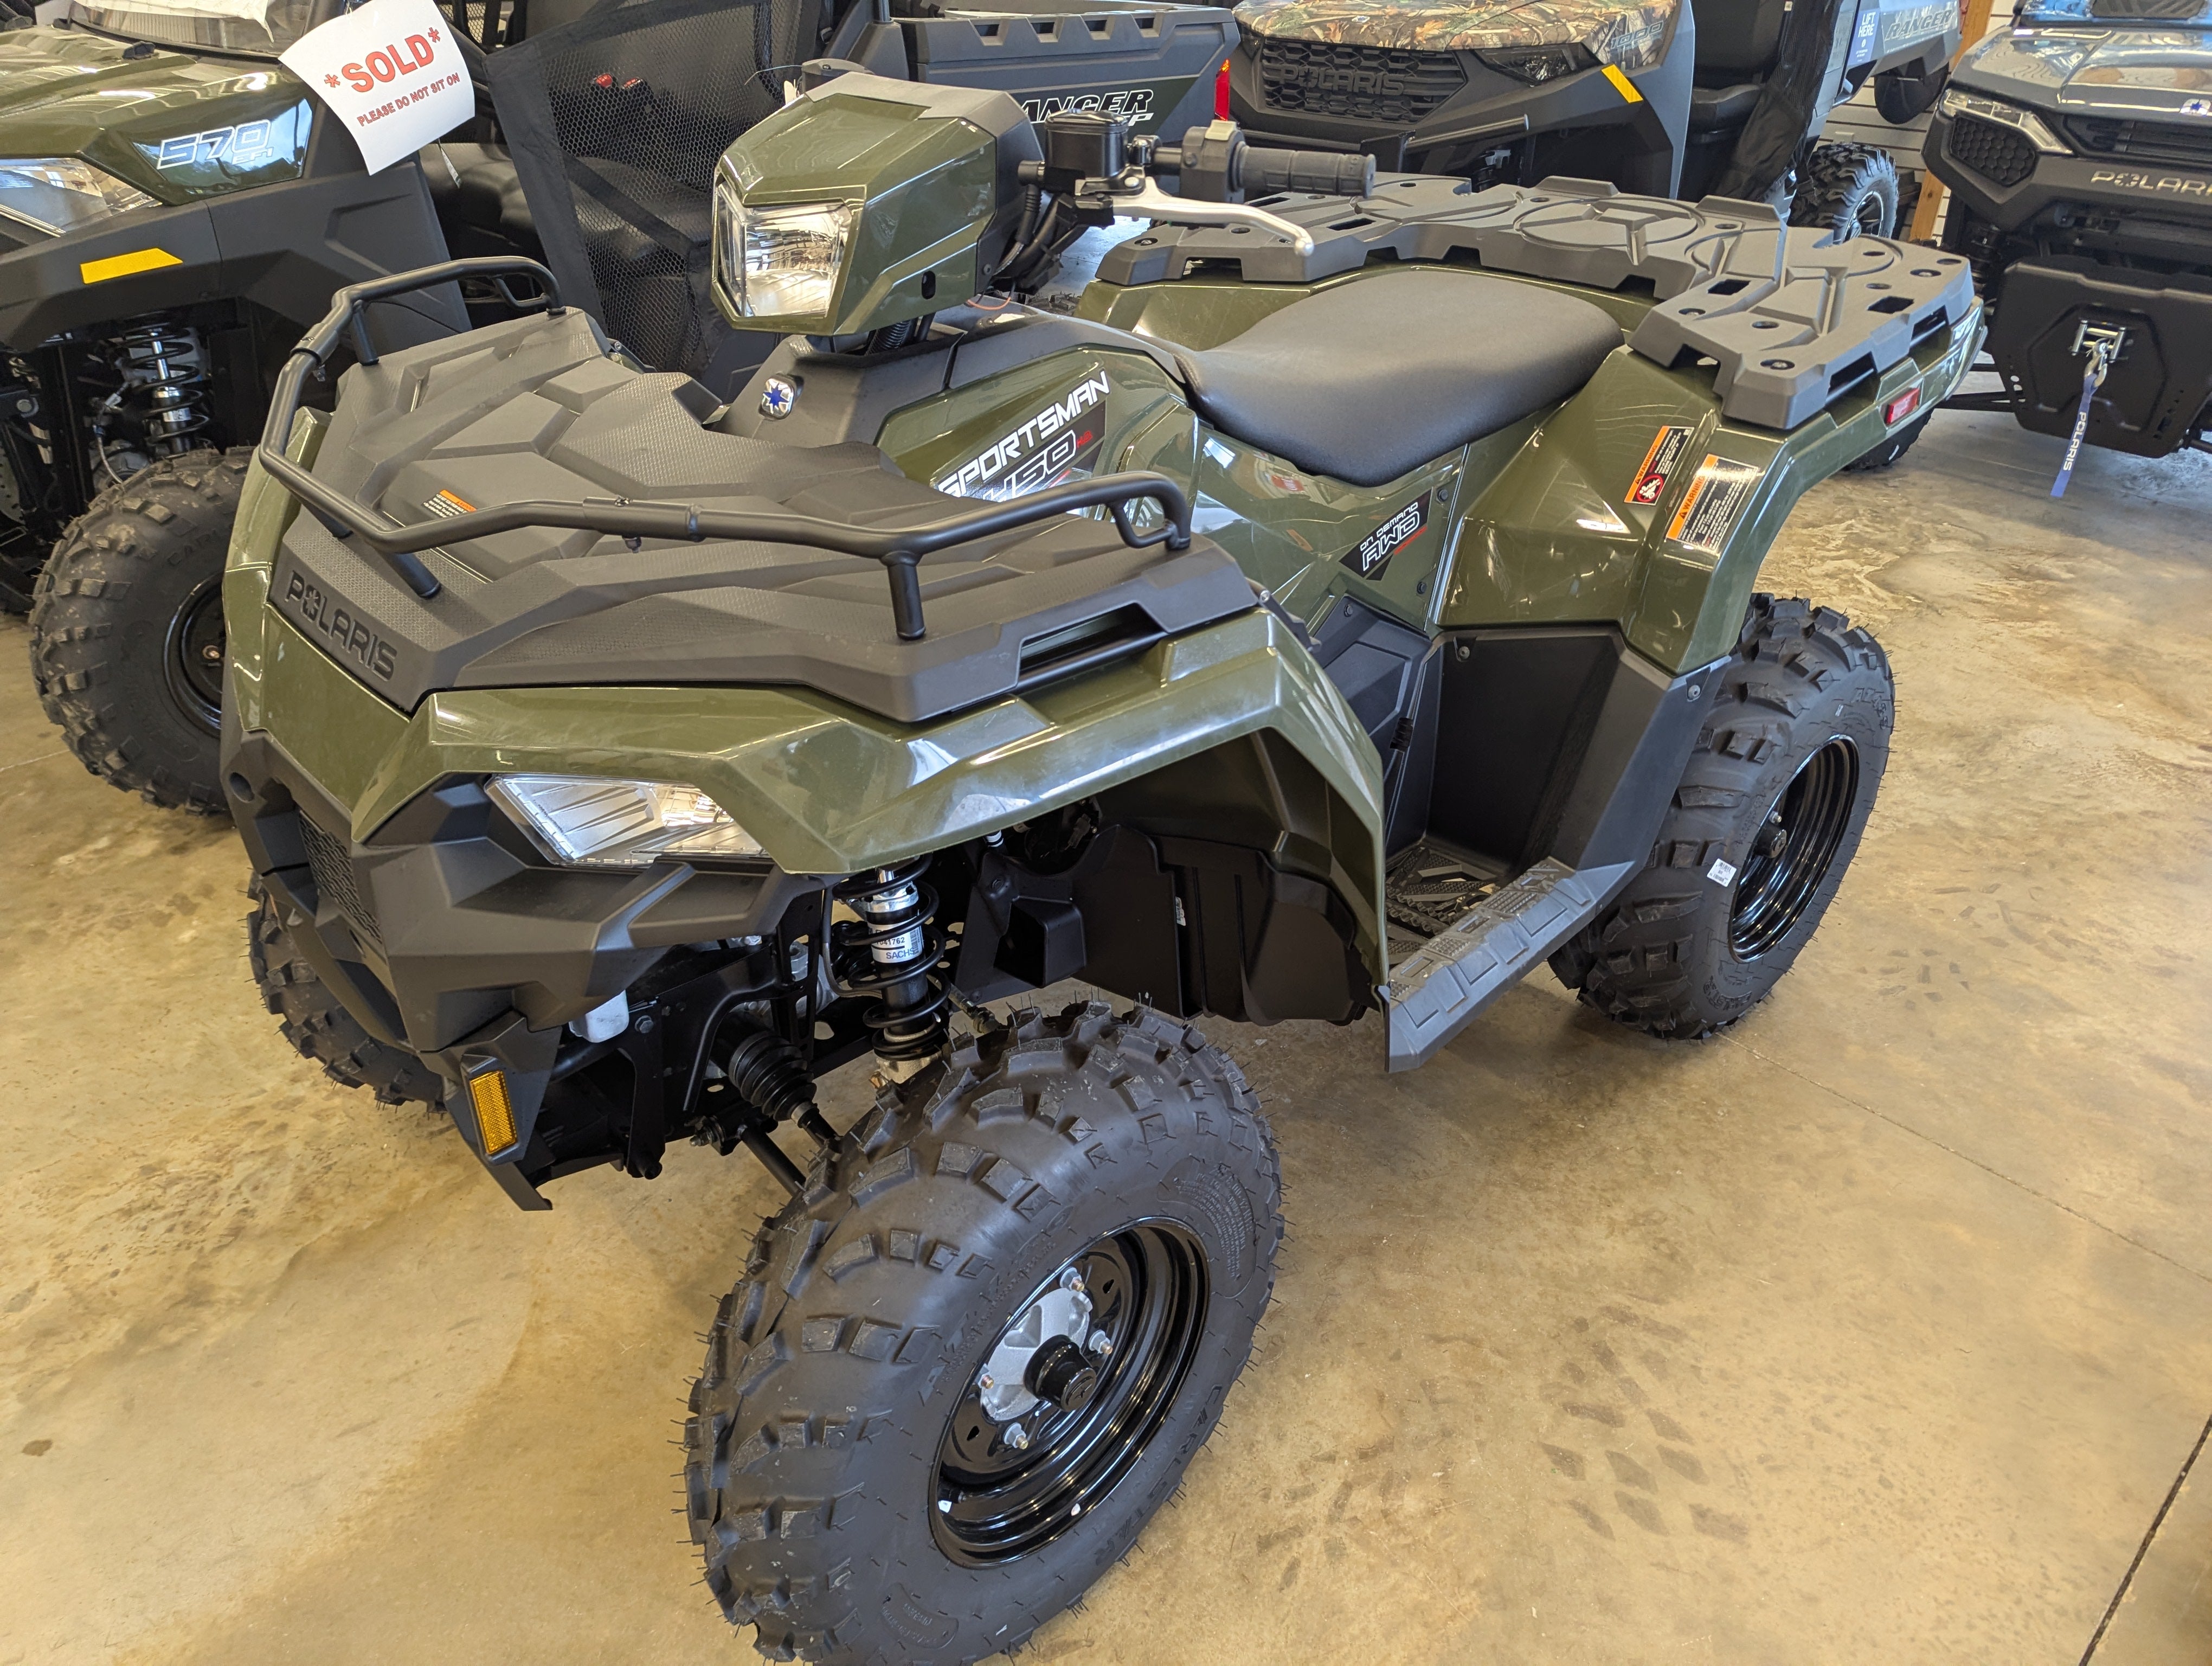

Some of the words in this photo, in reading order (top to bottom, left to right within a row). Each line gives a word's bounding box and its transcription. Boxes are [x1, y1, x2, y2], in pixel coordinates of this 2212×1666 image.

[1610, 20, 1664, 50] 1000
[1858, 24, 1874, 38] HERE
[1862, 12, 1876, 25] LIFT
[1884, 9, 1953, 41] RANGER
[1279, 65, 1405, 96] POLARIS
[356, 102, 396, 127] PLEASE
[394, 96, 410, 110] DO
[410, 86, 429, 102] NOT
[430, 79, 444, 93] SIT
[446, 72, 461, 86] ON
[1019, 89, 1154, 124] ANGER
[157, 119, 271, 170] 570
[232, 146, 274, 165] EFI
[937, 370, 1110, 498] SPORTSMAN
[2063, 412, 2087, 471] POLARIS
[1639, 445, 1658, 477] WARNING
[1682, 475, 1706, 511] WARNING
[1360, 536, 1374, 552] ON
[1376, 502, 1419, 537] DEMAND
[1362, 510, 1420, 572] AWD
[285, 570, 397, 682] POLARIS
[886, 947, 916, 959] SACHS
